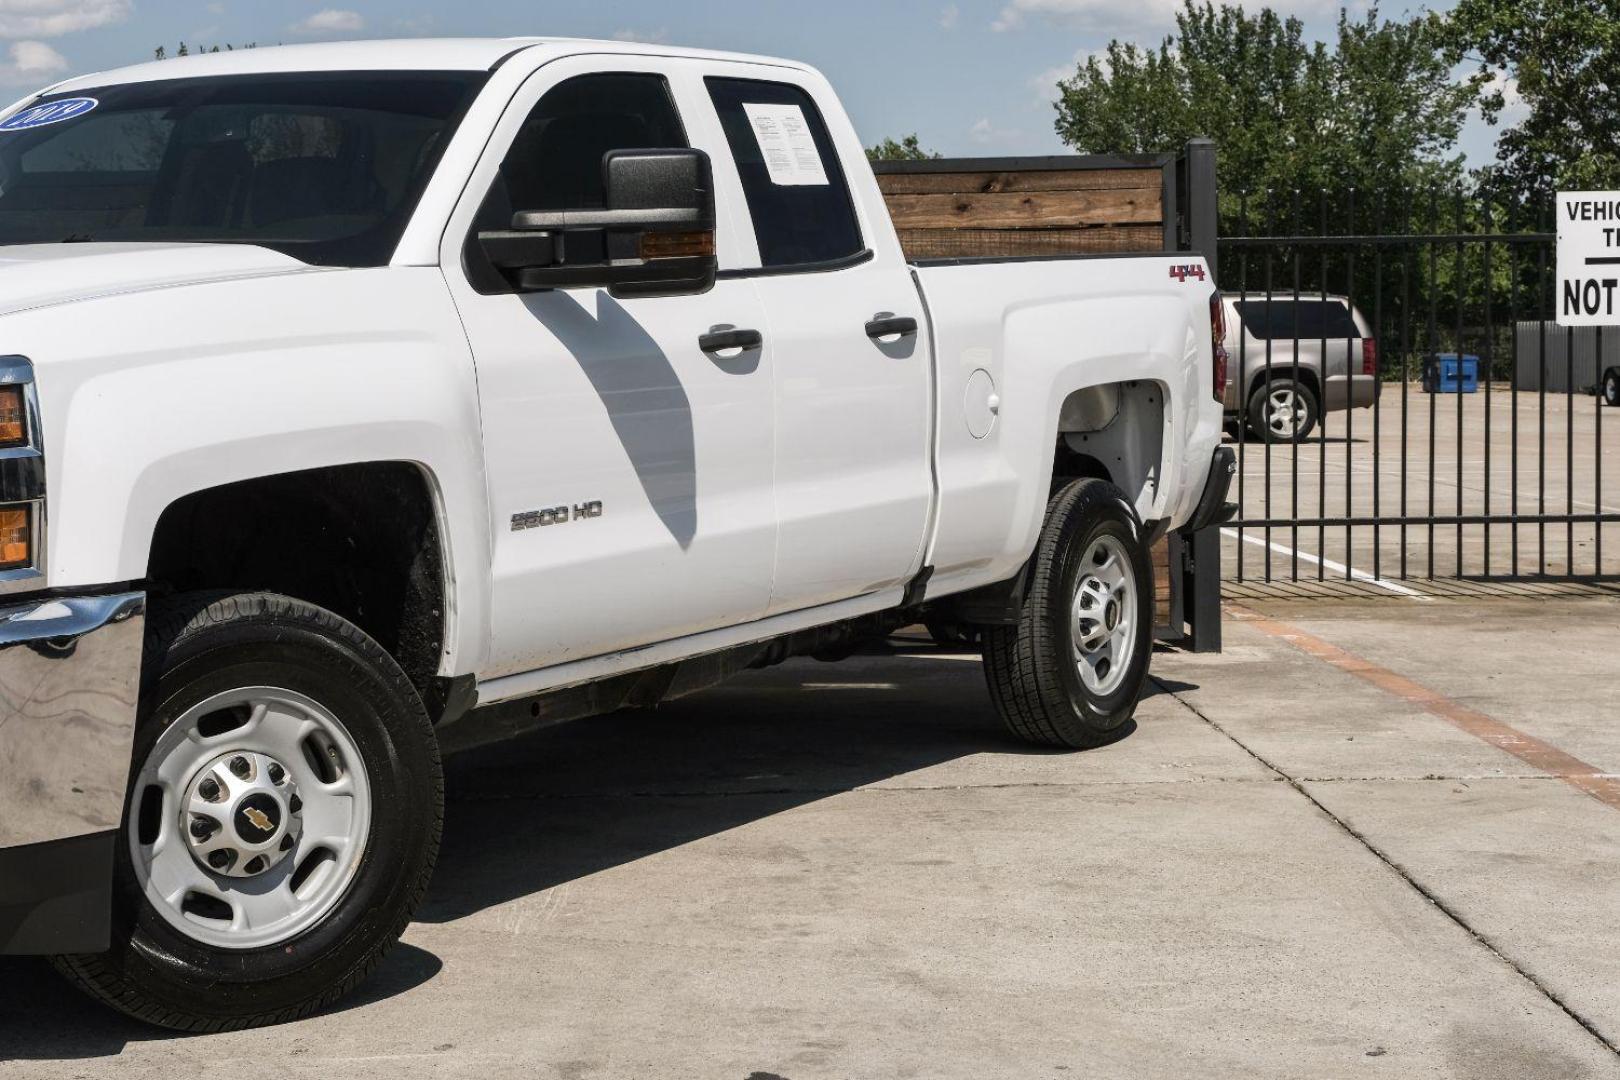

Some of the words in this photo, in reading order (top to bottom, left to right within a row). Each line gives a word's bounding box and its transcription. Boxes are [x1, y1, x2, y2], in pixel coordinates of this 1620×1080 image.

[5, 101, 88, 127] 2019
[1602, 227, 1620, 247] T
[1563, 278, 1618, 316] NOT
[510, 506, 568, 531] 2500
[573, 500, 602, 521] HD
